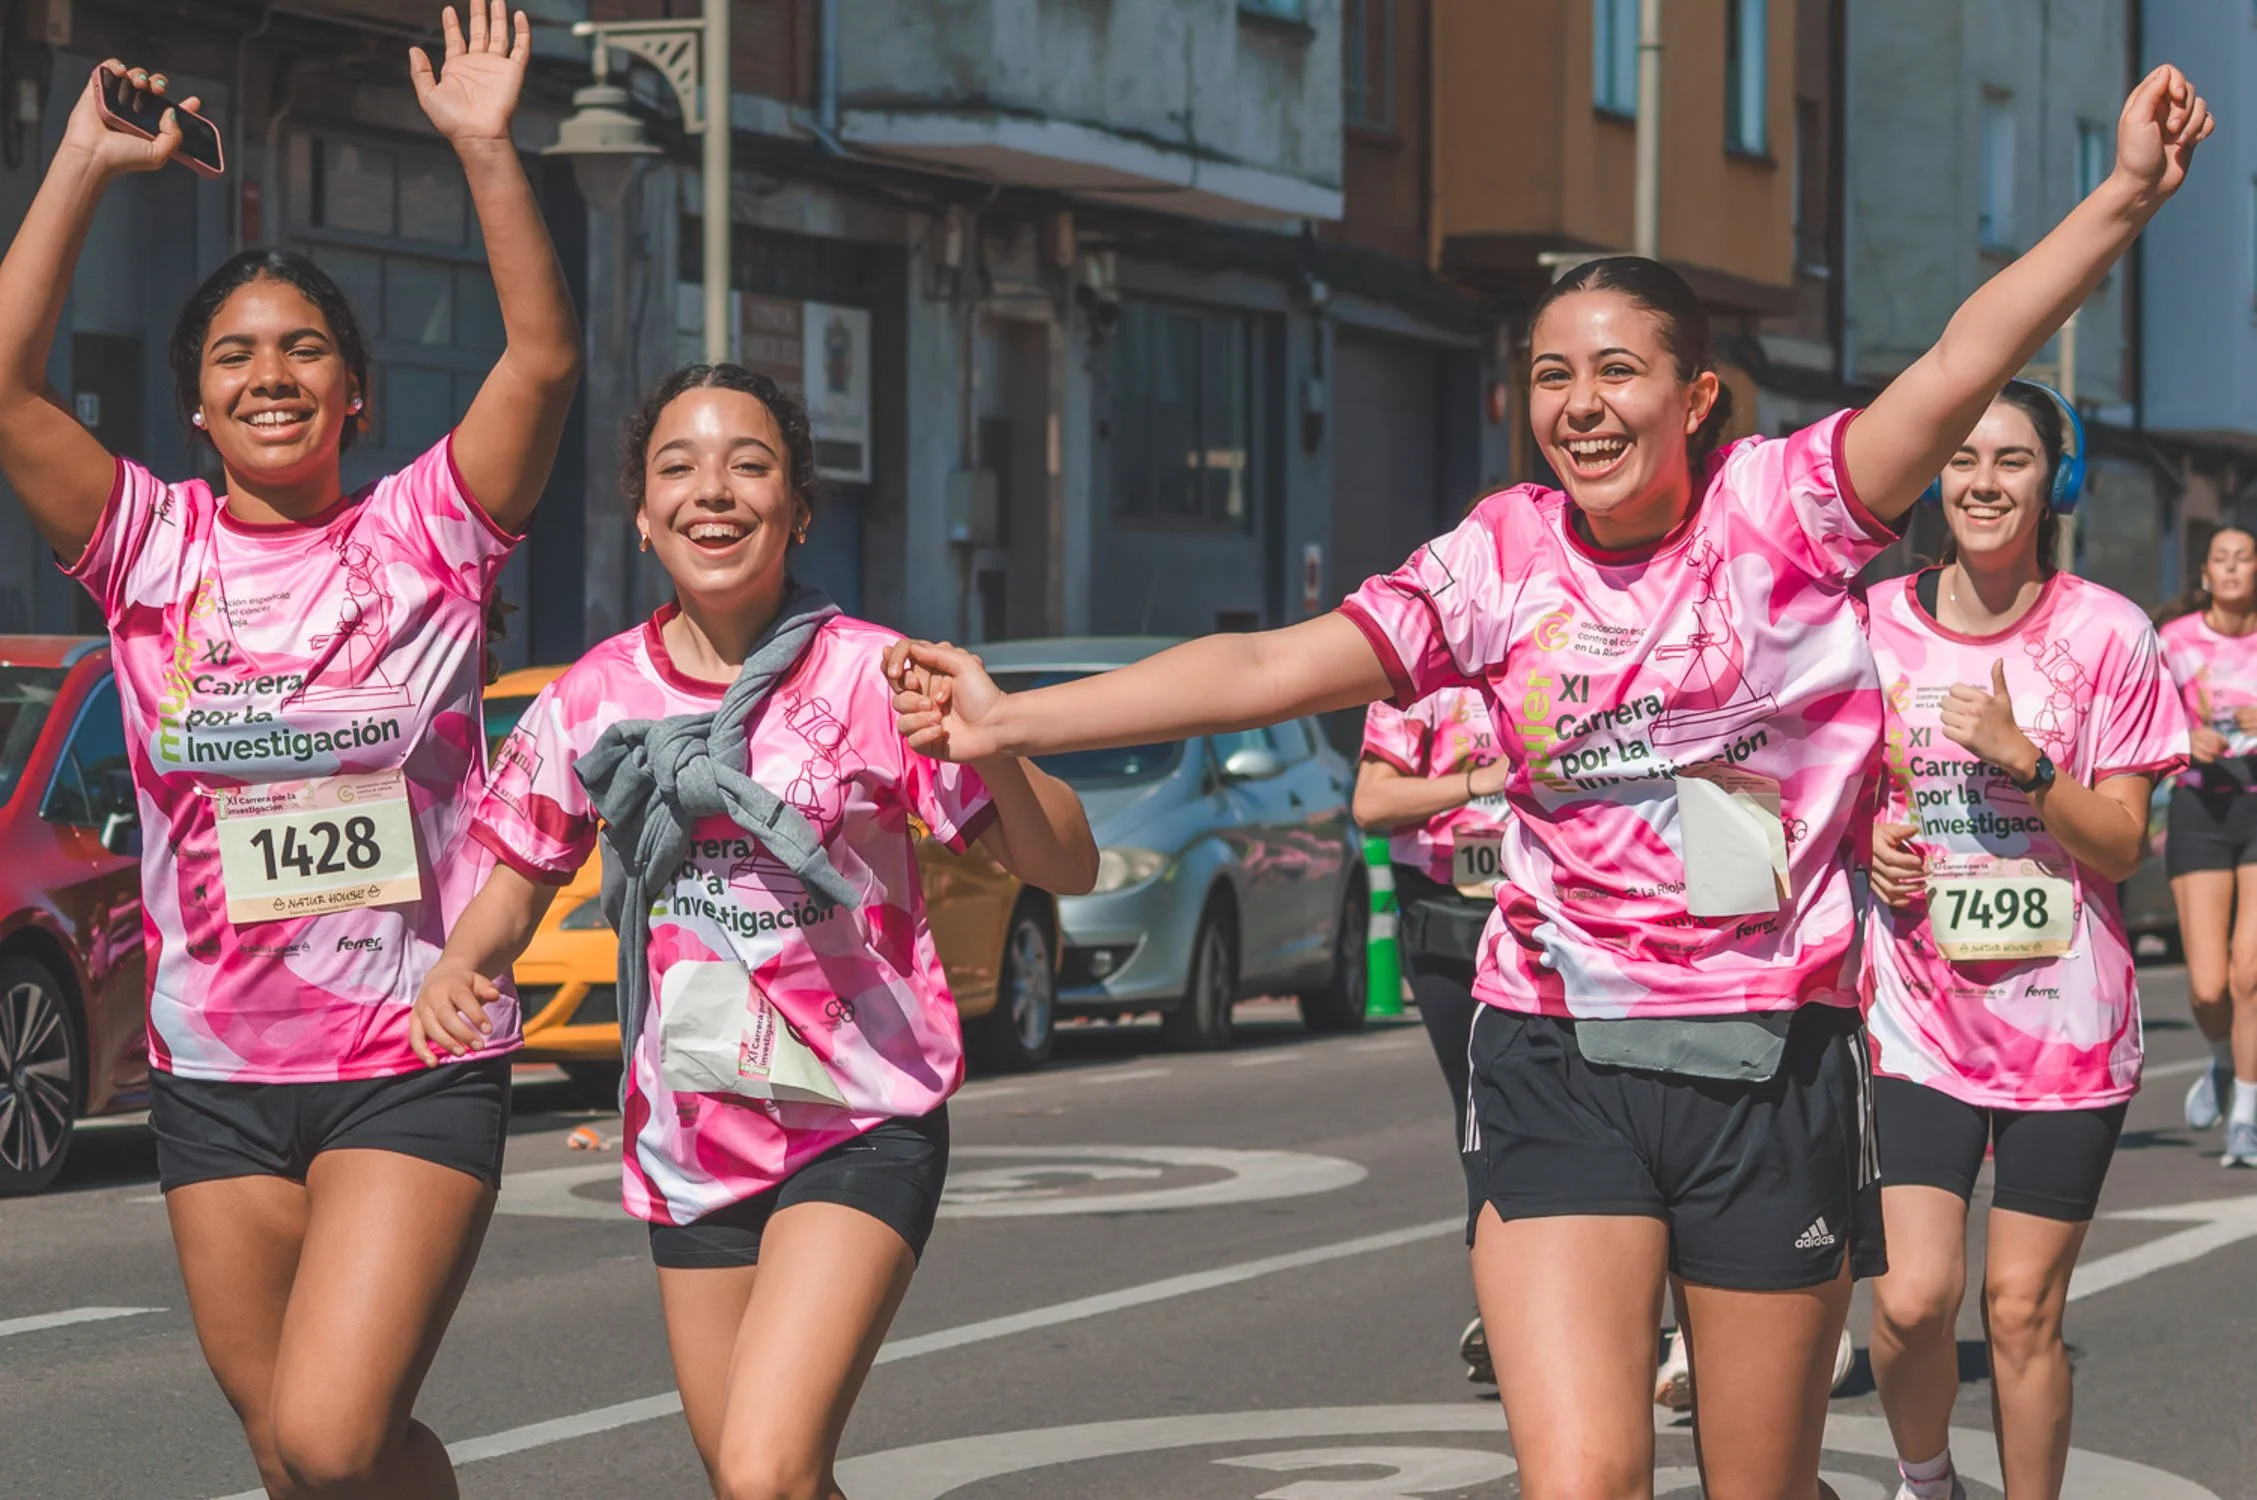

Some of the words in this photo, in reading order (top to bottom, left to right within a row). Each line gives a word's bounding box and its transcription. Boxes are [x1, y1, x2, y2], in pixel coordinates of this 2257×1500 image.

[199, 638, 232, 666] XI
[193, 674, 305, 696] Carrera
[1558, 673, 1589, 703] XI
[185, 709, 238, 732] por
[243, 705, 274, 724] la
[1556, 693, 1664, 741] Carrera
[187, 717, 400, 763] Investigación
[1473, 732, 1491, 749] XI
[1908, 727, 1931, 748] XI
[1560, 744, 1611, 780] por
[1618, 737, 1650, 762] la
[1915, 788, 1952, 813] por
[1957, 783, 1982, 805] la
[250, 815, 381, 881] 1428
[287, 894, 326, 909] NATUR
[1642, 888, 1655, 898] La
[1657, 880, 1687, 895] Rioja
[1945, 887, 2049, 930] 7498
[1794, 1234, 1835, 1249] adidas
